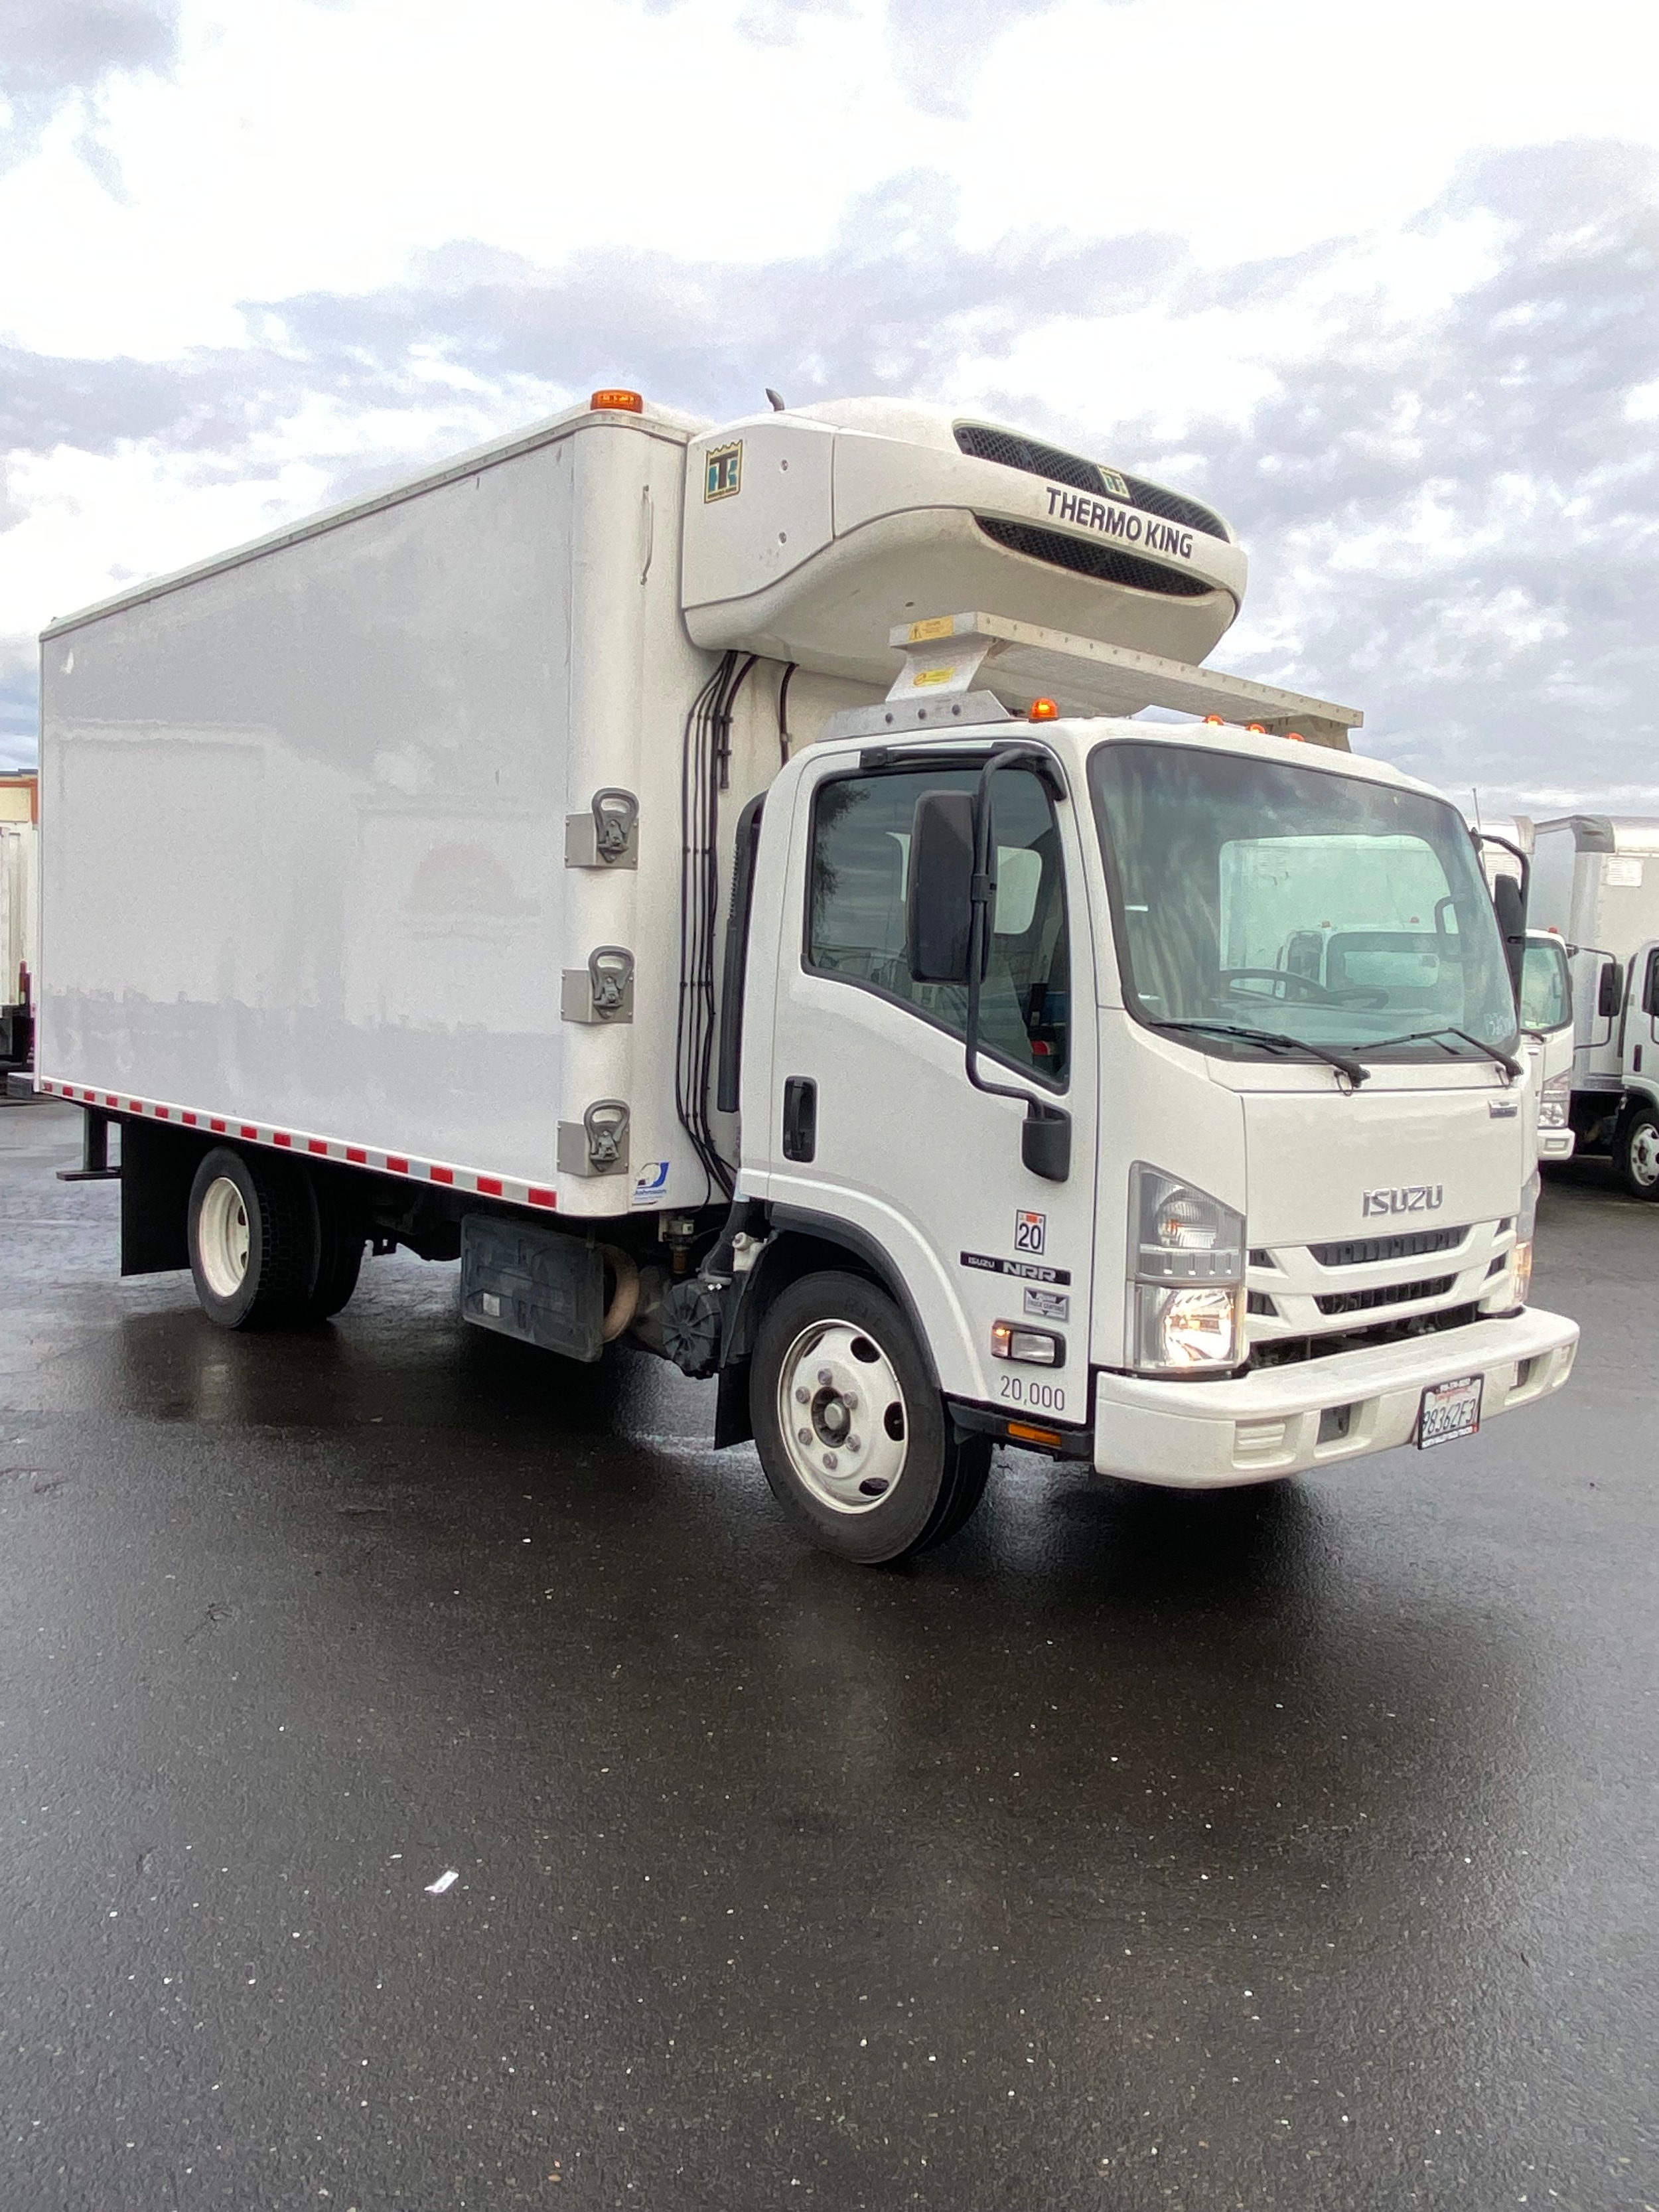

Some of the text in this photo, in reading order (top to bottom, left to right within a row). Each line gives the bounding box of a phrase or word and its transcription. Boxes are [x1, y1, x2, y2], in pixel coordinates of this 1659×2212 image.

[1046, 486, 1193, 559] THERMO KING
[1362, 1184, 1443, 1217] ISUZU
[1018, 1222, 1041, 1250] 20
[968, 1256, 1056, 1282] ISUZU NRR
[1000, 1375, 1064, 1411] 20,000
